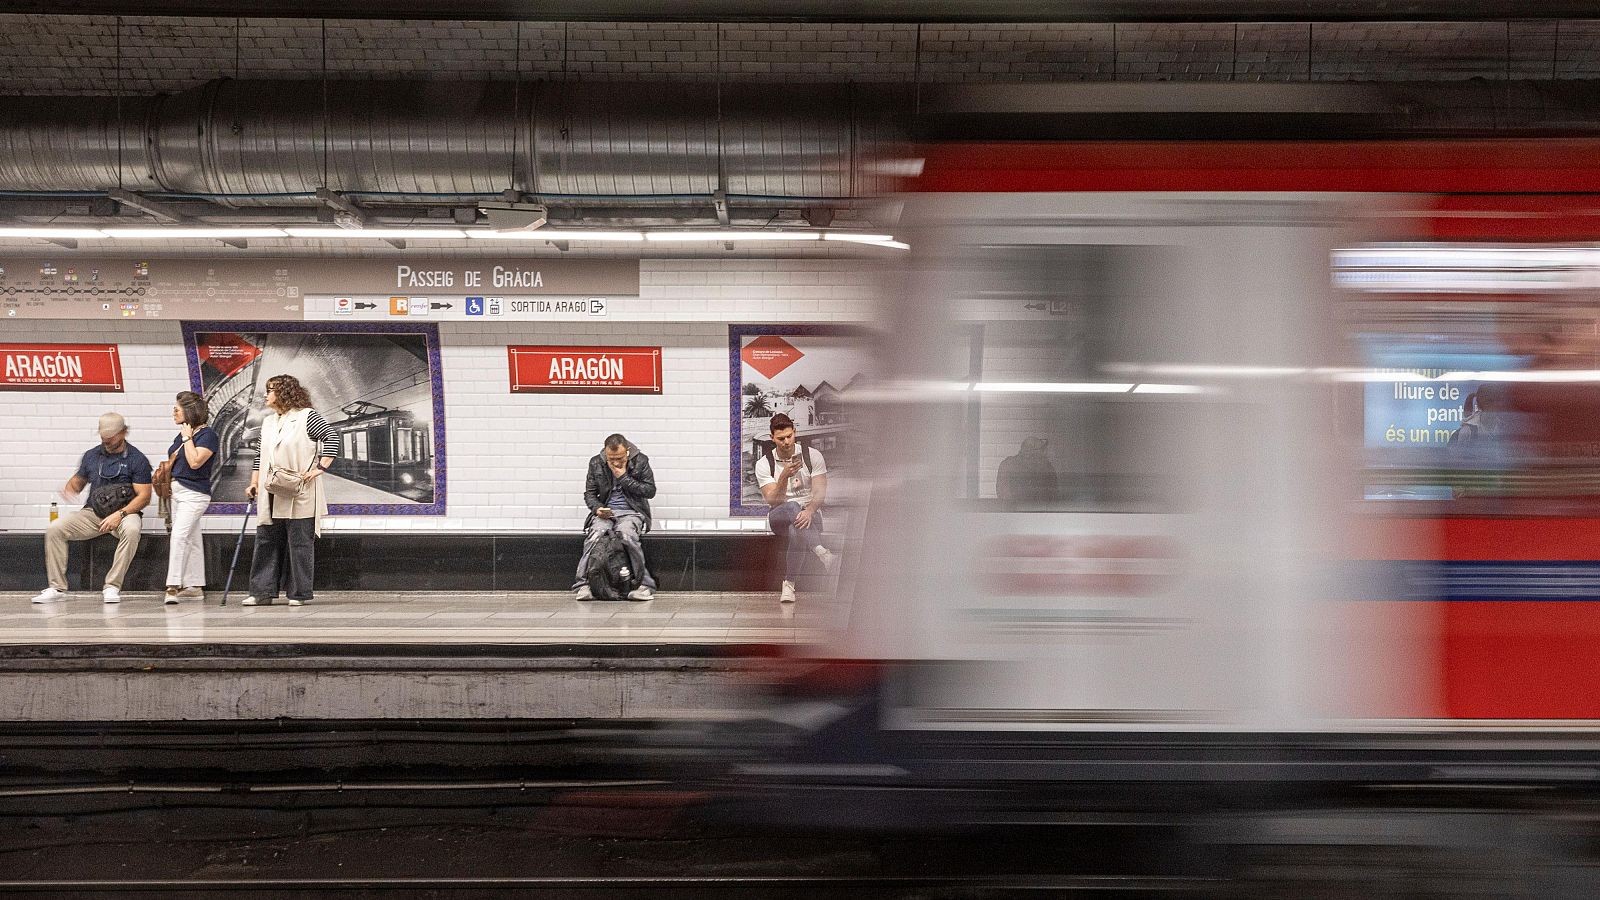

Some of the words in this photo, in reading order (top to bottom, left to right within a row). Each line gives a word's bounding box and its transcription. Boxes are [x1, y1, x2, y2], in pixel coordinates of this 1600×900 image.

[397, 299, 408, 311] R
[511, 301, 551, 313] SORTIDA
[555, 298, 587, 313] ARAGÓ
[5, 351, 83, 378] ARAGÓN
[548, 354, 624, 380] ARAGÓN
[1394, 382, 1435, 400] lliure
[1439, 382, 1460, 400] de
[1385, 424, 1406, 442] és
[1410, 428, 1430, 442] un
